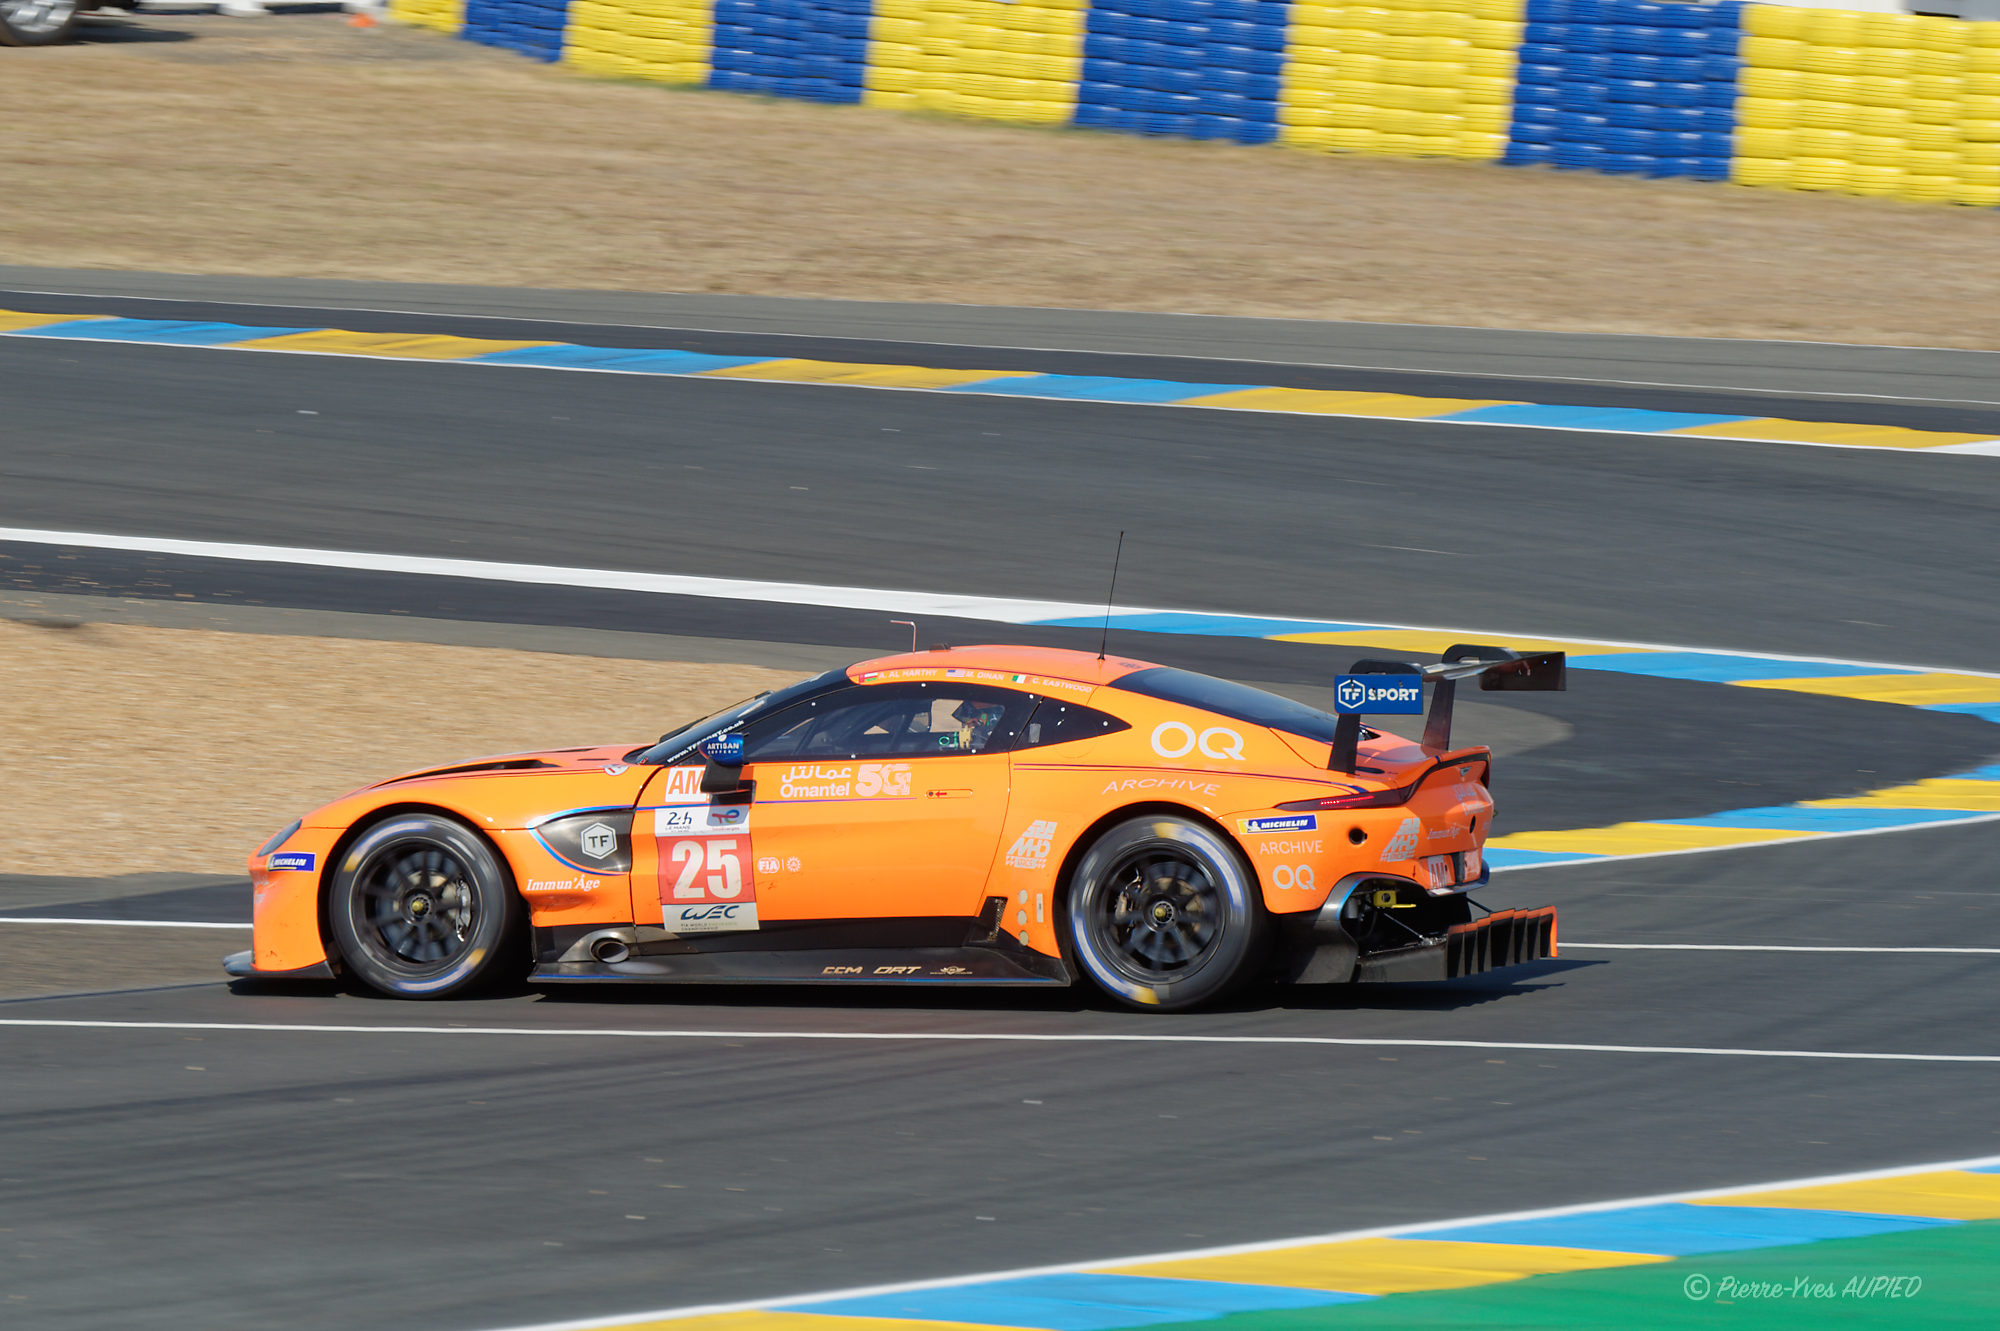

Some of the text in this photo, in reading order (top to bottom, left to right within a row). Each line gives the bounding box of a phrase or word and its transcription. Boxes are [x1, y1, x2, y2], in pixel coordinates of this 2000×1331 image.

[902, 669, 937, 677] HARTHY
[978, 672, 1004, 680] DINAN
[1042, 680, 1092, 692] EASTWOOD
[1342, 688, 1419, 701] TF SPORT
[707, 742, 740, 750] ARTISAN
[1151, 721, 1246, 761] OQ
[855, 763, 912, 797] 5G
[780, 782, 850, 798] Omantel
[1101, 778, 1222, 797] ARCHIVE
[1260, 819, 1308, 829] MICHELIN
[588, 835, 609, 848] TF
[1259, 840, 1324, 855] ARCHIVE
[672, 839, 742, 898] 25
[759, 861, 777, 870] FIA
[1272, 864, 1316, 890] OQ
[680, 905, 739, 921] WEC
